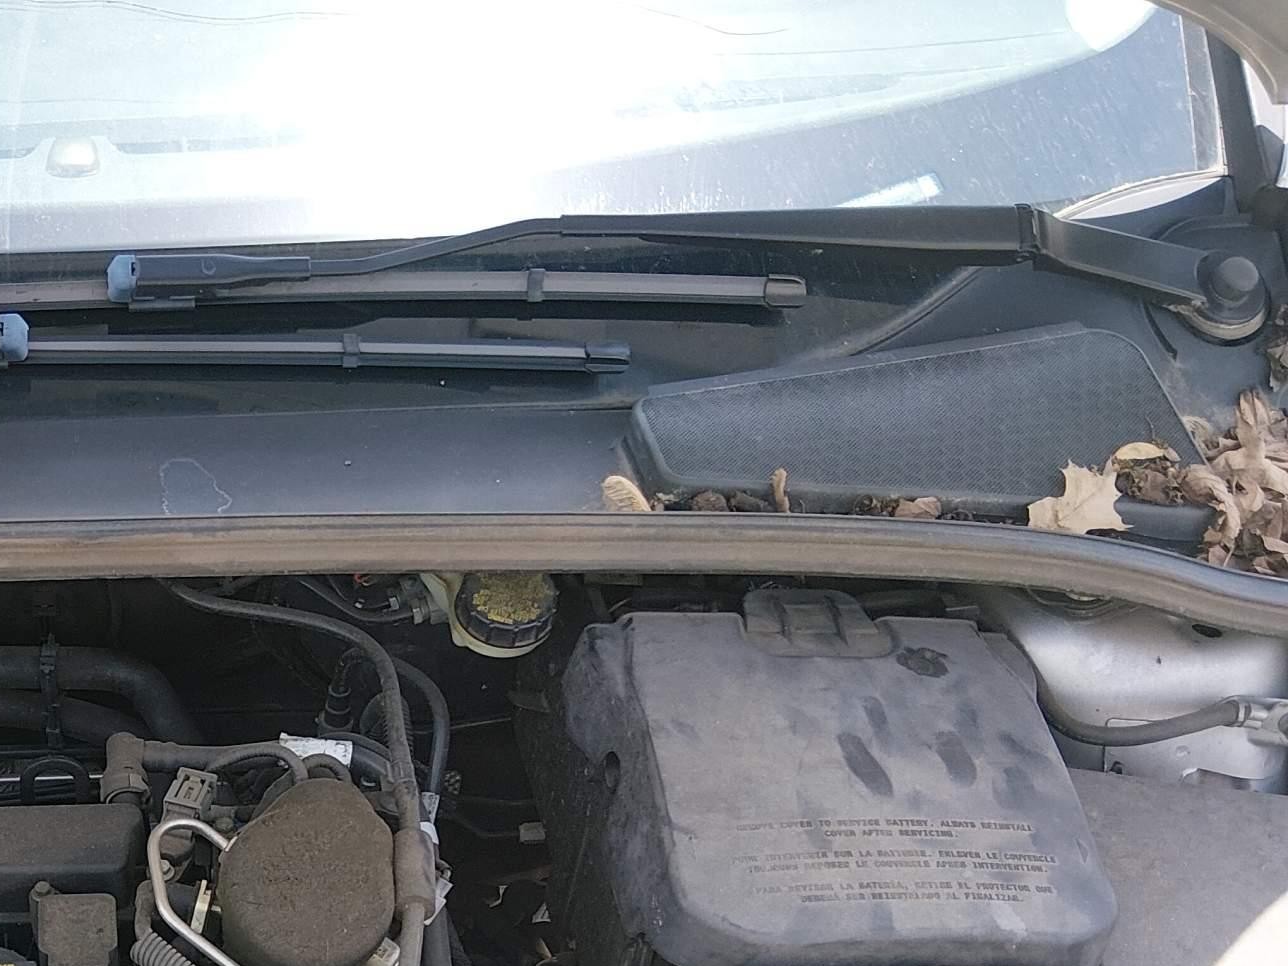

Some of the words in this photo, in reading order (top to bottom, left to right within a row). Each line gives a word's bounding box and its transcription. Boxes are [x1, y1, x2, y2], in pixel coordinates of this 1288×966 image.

[818, 818, 832, 827] TO
[824, 829, 857, 838] COVER
[862, 829, 893, 838] AFTER
[859, 849, 873, 858] LA
[986, 852, 999, 861] LE
[855, 860, 869, 869] LE
[839, 882, 854, 891] LA
